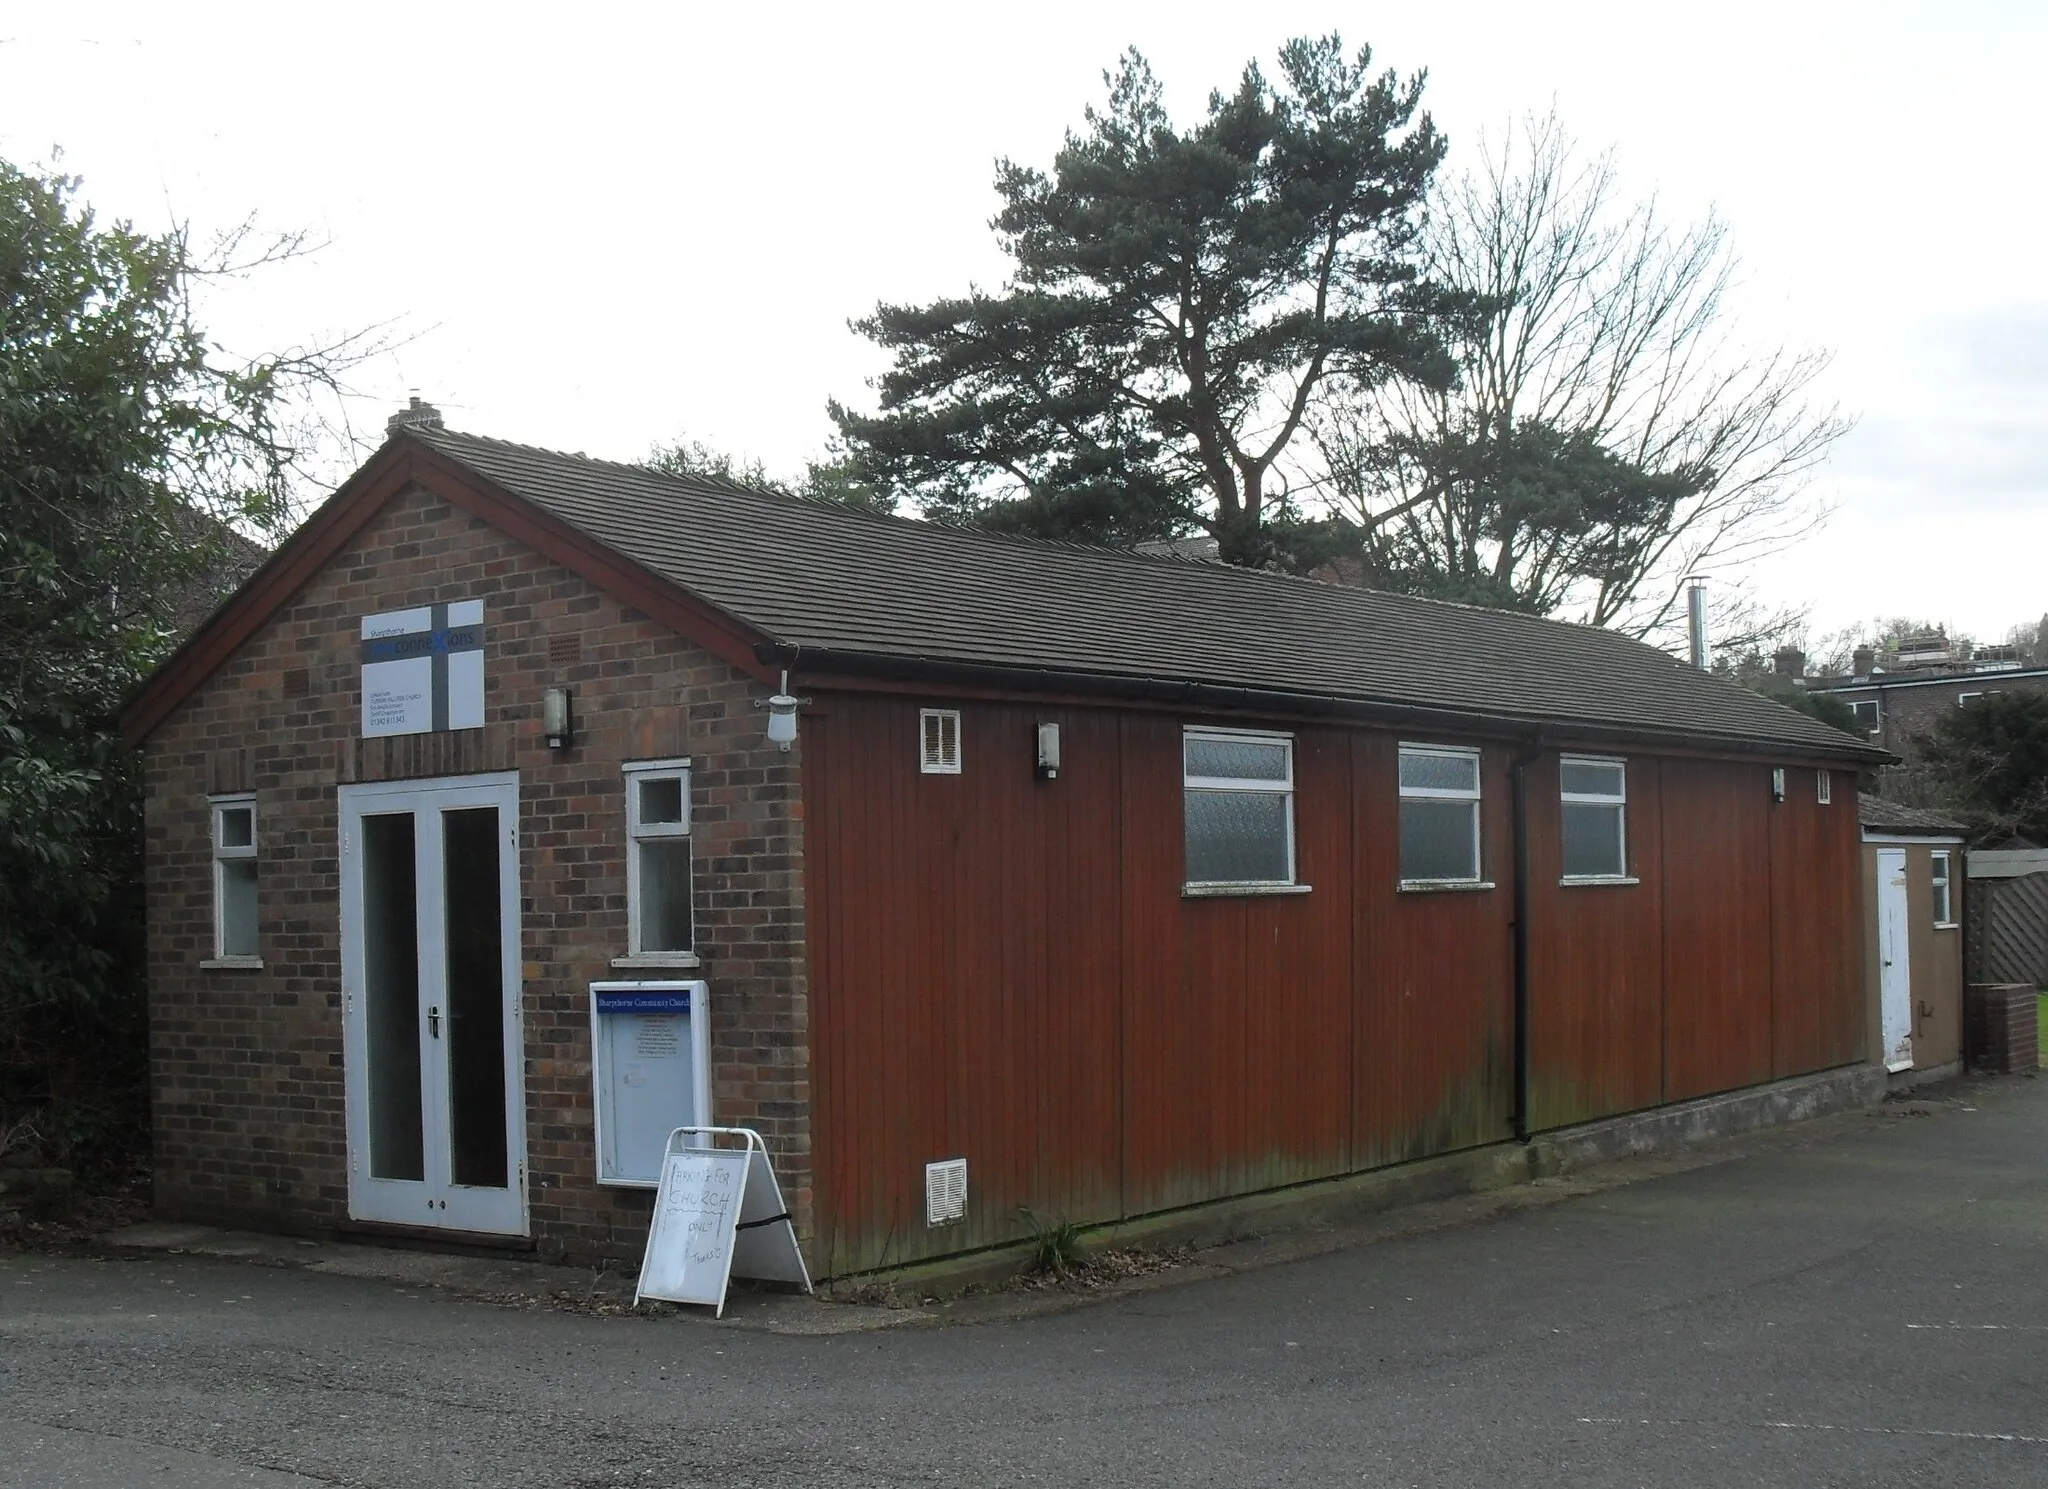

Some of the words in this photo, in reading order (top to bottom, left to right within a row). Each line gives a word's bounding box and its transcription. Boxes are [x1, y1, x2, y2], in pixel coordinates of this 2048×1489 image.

[370, 628, 405, 637] Sharpthorne
[598, 999, 633, 1008] Sharpthorne
[634, 998, 668, 1008] Community
[669, 998, 691, 1007] Church
[670, 1190, 730, 1210] CHURCH
[688, 1221, 713, 1232] ONLY
